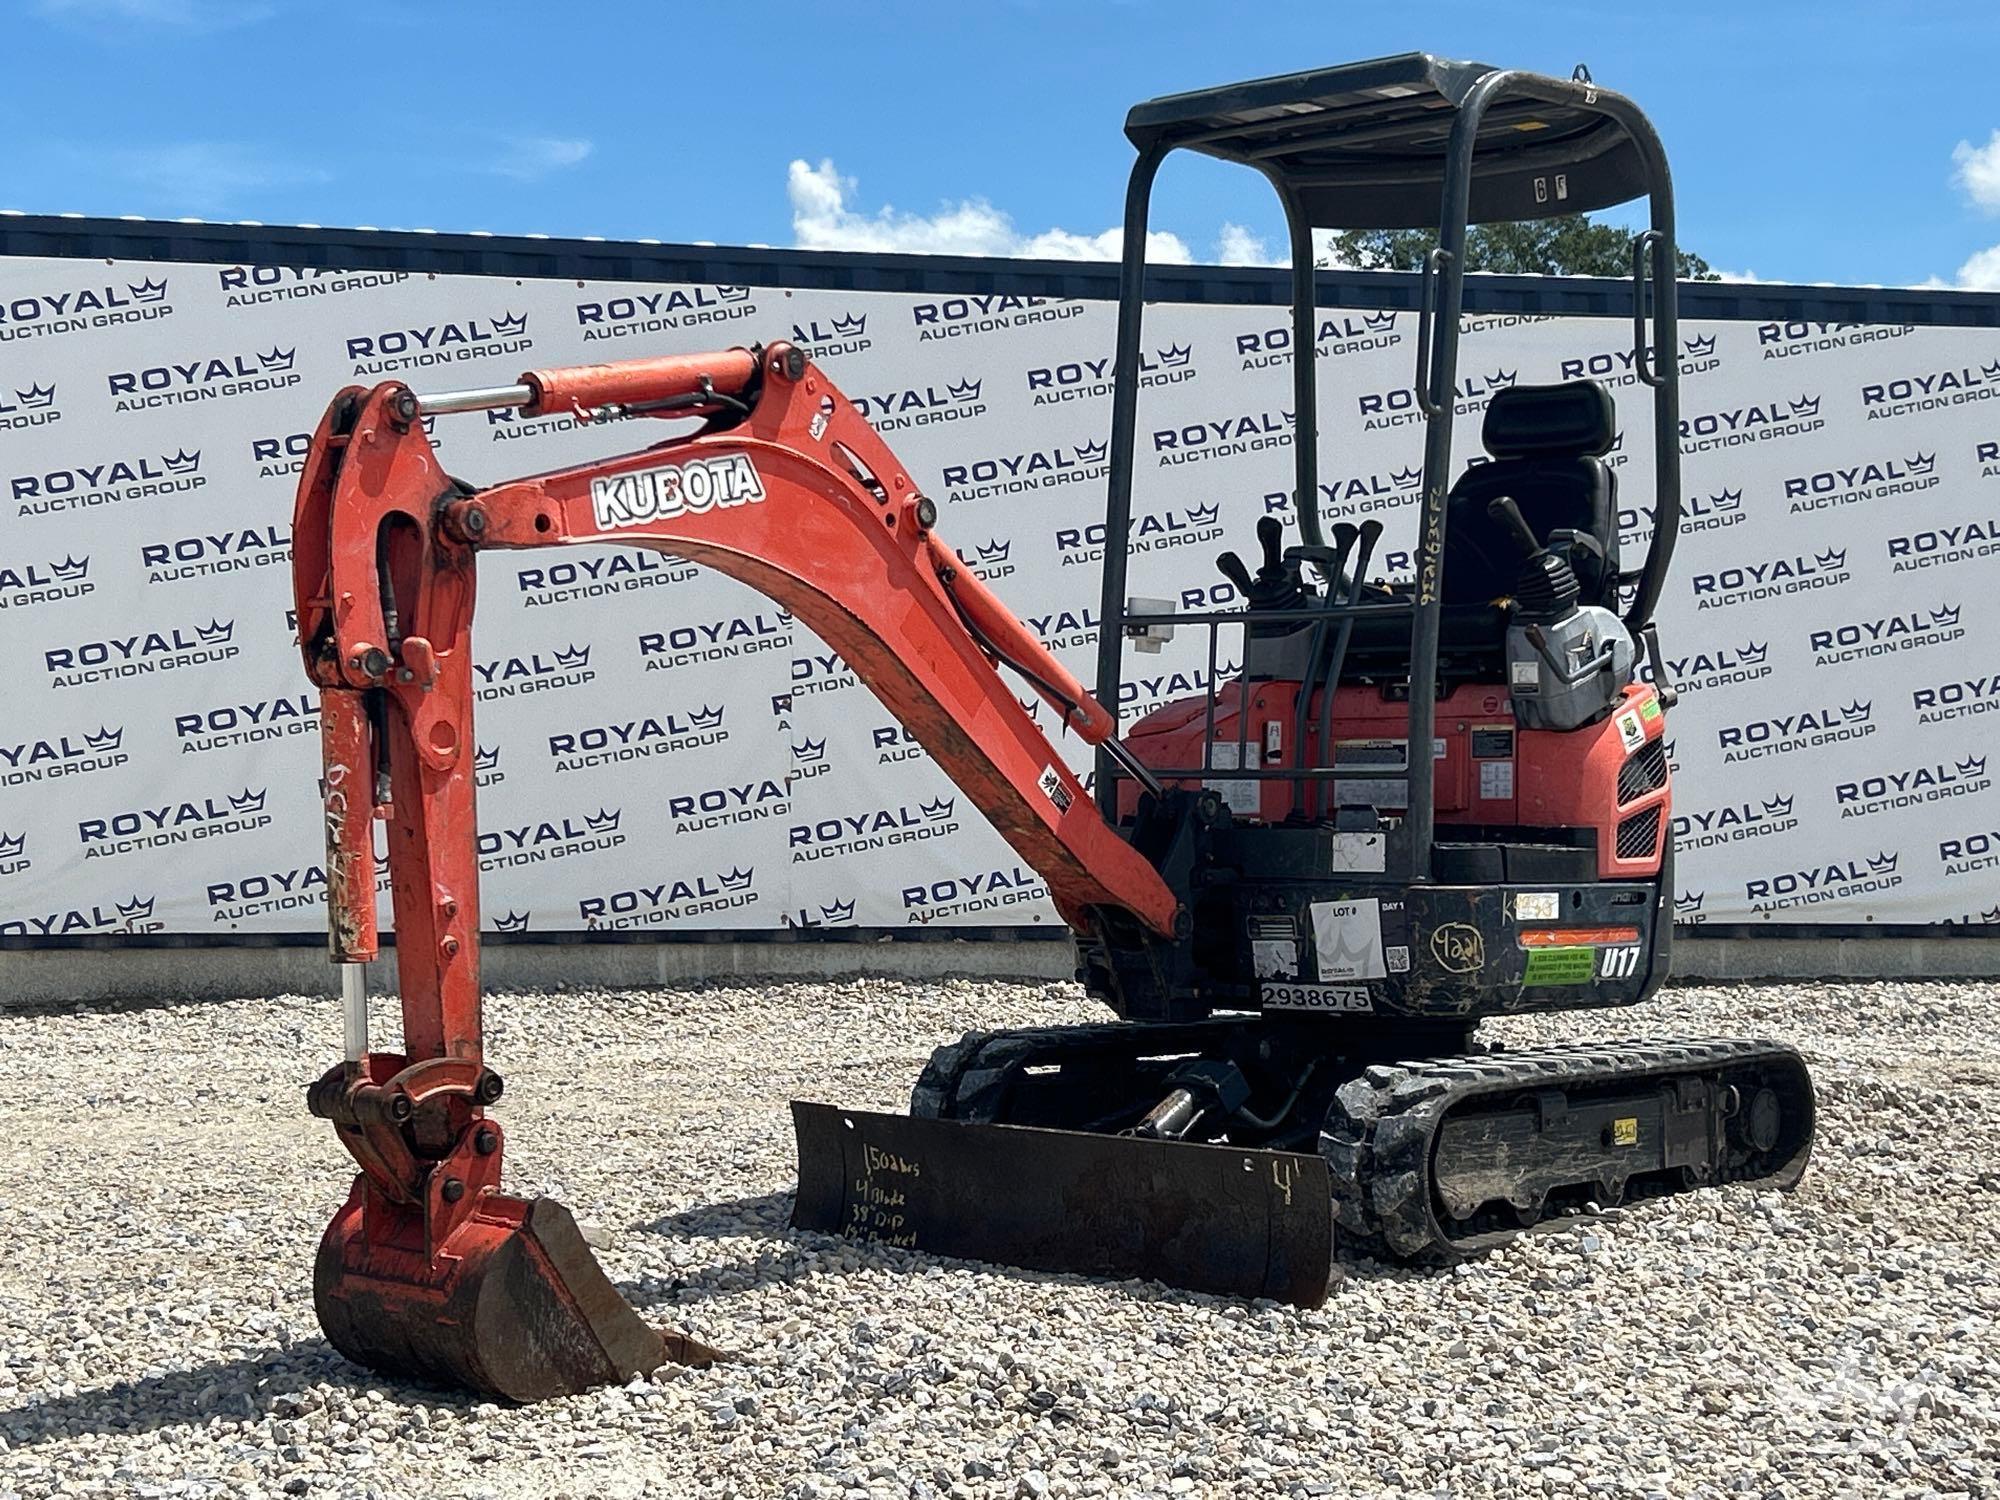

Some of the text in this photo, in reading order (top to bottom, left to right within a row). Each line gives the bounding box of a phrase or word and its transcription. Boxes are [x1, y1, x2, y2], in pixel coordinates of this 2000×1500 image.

[0, 287, 129, 321] OYAL
[227, 284, 327, 307] AUCTION
[577, 288, 716, 325] ROYAL
[0, 306, 172, 341] UCTION GROUP
[347, 322, 491, 359] ROYAL
[584, 305, 756, 341] AUCTION GROUP
[920, 306, 1084, 341] AUCTION GROUP
[1237, 319, 1364, 355] ROAL
[354, 340, 532, 376] AUCTION GROUP
[1242, 335, 1401, 371] AUCTN GROUP
[1764, 325, 1914, 360] AUCTION GROUP
[109, 356, 258, 396] ROYAL
[116, 375, 301, 412] AUCTION GROUP
[1862, 369, 1982, 405] ROYAL
[850, 388, 946, 416] OYAL
[916, 405, 986, 425] GROUP
[1868, 388, 2000, 420] AUCTION GROU
[1153, 413, 1282, 451] ROYAL
[1159, 433, 1295, 467] AUCTION GRO
[1678, 420, 1824, 456] UCTION GROUP
[11, 459, 163, 499] ROYAL
[943, 449, 1074, 487] ROYAL
[1785, 462, 1905, 498] ROYAL
[18, 477, 206, 516] AUCTION GROUP
[594, 454, 764, 528] KUBOTA
[949, 479, 1038, 503] AUCTION
[1264, 475, 1391, 513] RYAL
[1790, 477, 1939, 514] AUCTION GROUP
[1164, 529, 1223, 549] GROUP
[1681, 513, 1746, 533] GROUP
[142, 526, 292, 567] ROYAL
[1893, 549, 1973, 573] AUCTION
[149, 557, 250, 583] AUCTION
[518, 551, 658, 592] ROYAL
[524, 568, 699, 608] AUCTION GROUP
[974, 565, 1015, 581] OUP
[1693, 557, 1816, 595] ROYAL
[14, 583, 94, 606] GROUP
[1698, 573, 1850, 610] AUCTION GROUP
[45, 630, 196, 671] ROYAL
[639, 615, 777, 655] ROYAL
[1810, 614, 1930, 651] ROYAL
[1816, 629, 1964, 666] AUCTION GROUP
[53, 647, 239, 688] AUCTION GROUP
[472, 655, 555, 683] YAL
[646, 636, 792, 671] AUCTION GRO
[520, 671, 595, 693] GROUP
[791, 676, 855, 696] CTION
[1706, 666, 1772, 687] GROUP
[182, 726, 282, 754] AUCTION
[549, 715, 689, 756] ROYAL
[1719, 710, 1841, 748] ROYAL
[1724, 725, 1875, 763] AUCTION GROUP
[0, 737, 85, 767] YAL
[47, 754, 128, 777] GROUP
[555, 731, 728, 772] AUCTION GROUP
[669, 780, 791, 818] ROYA
[1836, 765, 1956, 804] ROYAL
[1842, 780, 1991, 818] AUCTION GROUP
[79, 799, 229, 842] ROYAL
[85, 816, 271, 859] AUCTION GROUP
[478, 819, 586, 854] OYAL
[676, 807, 768, 834] AUCTION
[790, 807, 920, 848] ROYAL
[1674, 819, 1798, 852] CTION GROUP
[479, 835, 625, 871] CTION GROUP
[793, 823, 959, 863] AUCTION GROUP
[1746, 862, 1867, 900] ROYAL
[1945, 856, 1999, 876] AUCTI
[208, 866, 327, 905] ROYA
[579, 878, 719, 919] ROYAL
[902, 868, 1034, 908] ROYAL
[908, 883, 1051, 924] AUCTION GROU
[1750, 876, 1902, 914] AUCTION GROUP
[214, 894, 314, 922] AUCTION
[685, 893, 758, 916] GROUP
[1332, 906, 1350, 917] LOT
[1601, 947, 1640, 978] U17
[1262, 987, 1370, 1008] 2938675
